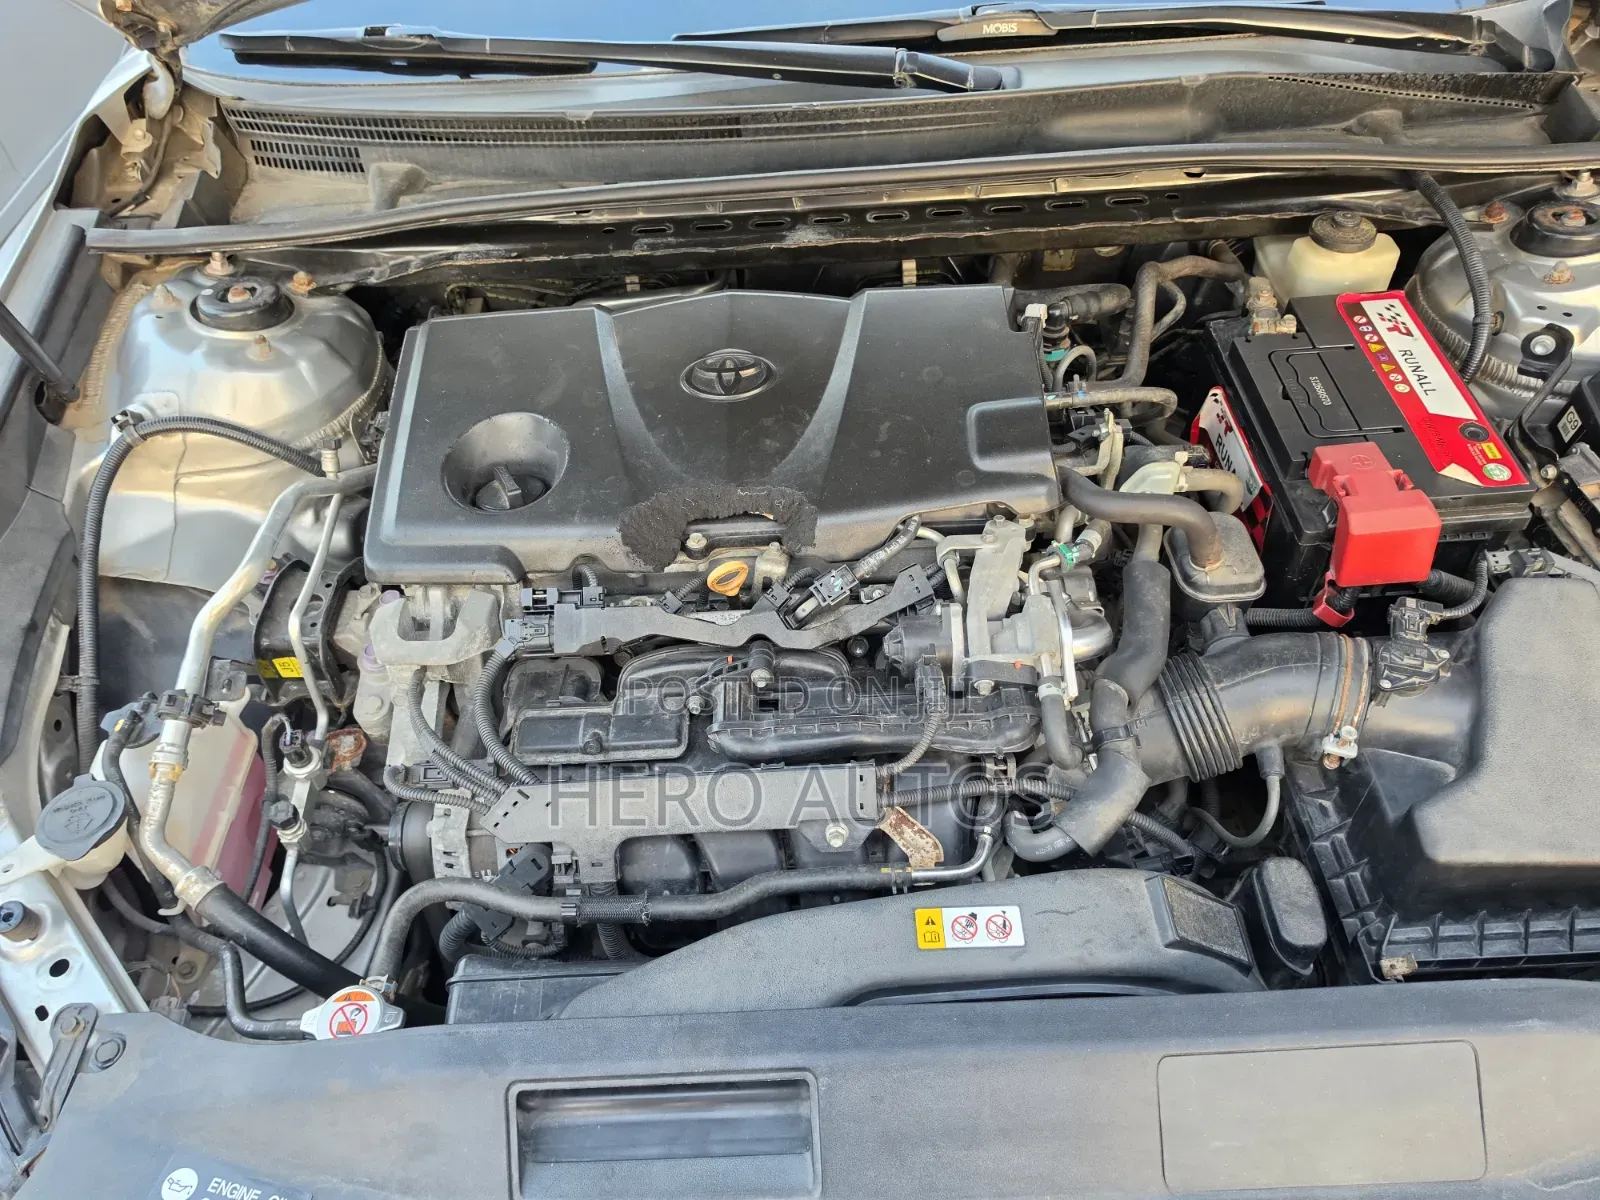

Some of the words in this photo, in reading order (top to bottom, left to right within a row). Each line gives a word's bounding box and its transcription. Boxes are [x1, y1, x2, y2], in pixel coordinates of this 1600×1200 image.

[982, 22, 1018, 35] MOBIS
[1398, 349, 1437, 396] RUNALL
[1566, 411, 1579, 431] G9
[278, 661, 294, 673] J5
[206, 1177, 262, 1200] ENGINE
